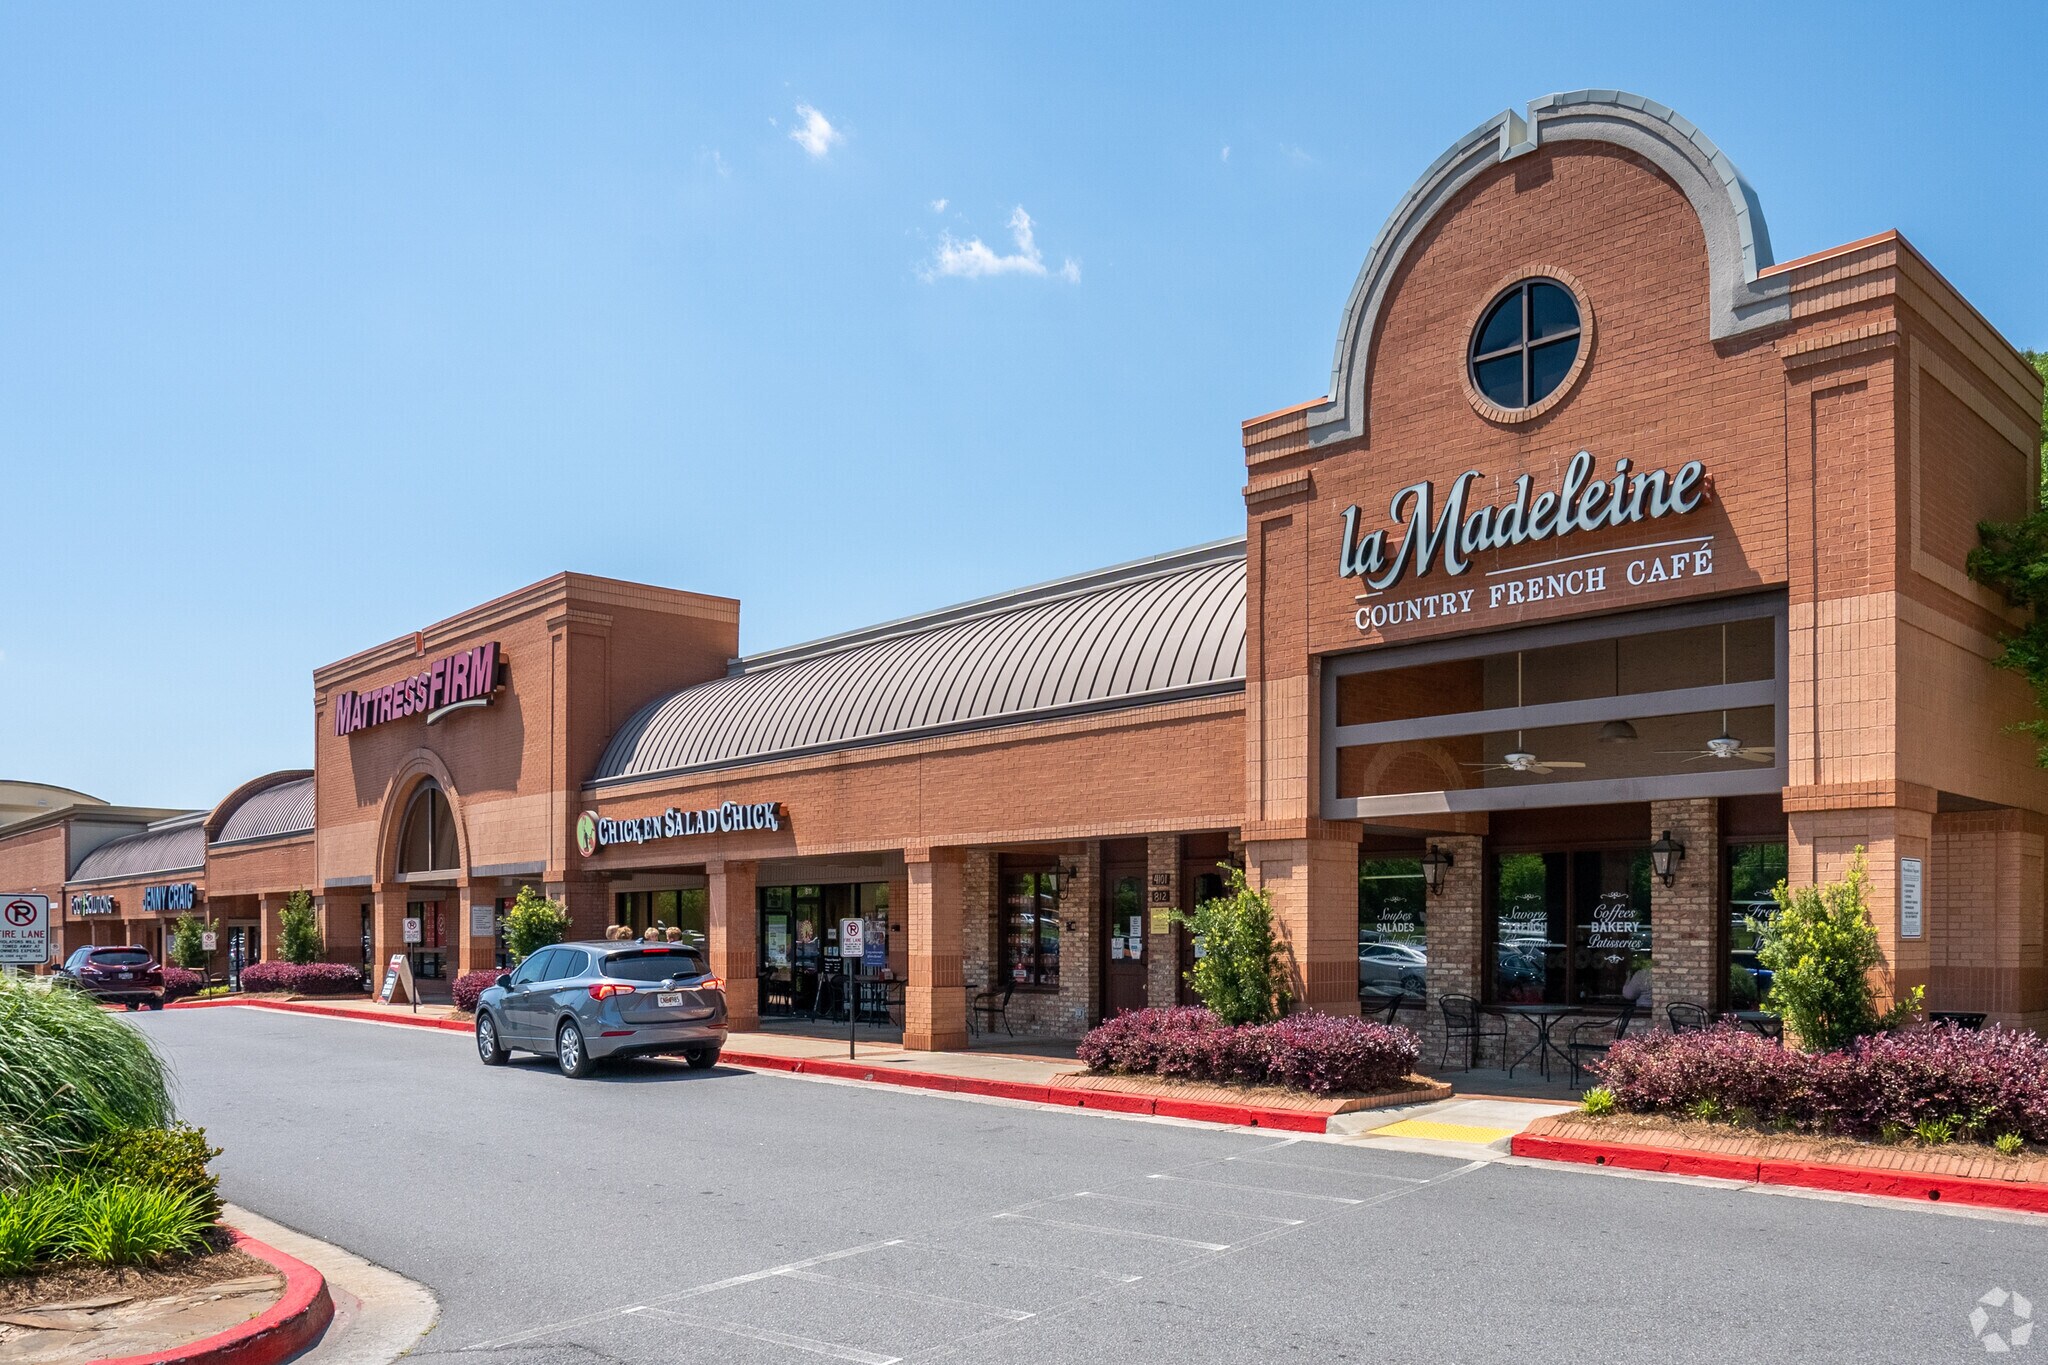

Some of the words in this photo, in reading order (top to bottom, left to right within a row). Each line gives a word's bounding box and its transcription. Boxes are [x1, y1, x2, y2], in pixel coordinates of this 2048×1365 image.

[1339, 504, 1391, 578] la
[1367, 450, 1706, 590] Madeleine
[1355, 589, 1475, 630] COUNTRY
[1489, 566, 1607, 609] FRENCH
[1626, 542, 1714, 586] CAFÉ
[598, 817, 663, 845] CHICKEN
[664, 807, 719, 838] SALAD
[719, 801, 779, 832] CHICK
[1154, 874, 1168, 884] 4101
[142, 887, 167, 911] JENNY
[168, 884, 194, 909] CRAIG
[1153, 891, 1167, 902] 812
[1505, 905, 1548, 922] Savory
[1593, 903, 1637, 923] Coffees
[21, 930, 45, 939] LANE
[1376, 922, 1415, 933] SALADES
[1591, 921, 1640, 933] BAKERY
[1587, 933, 1643, 949] Patisseries
